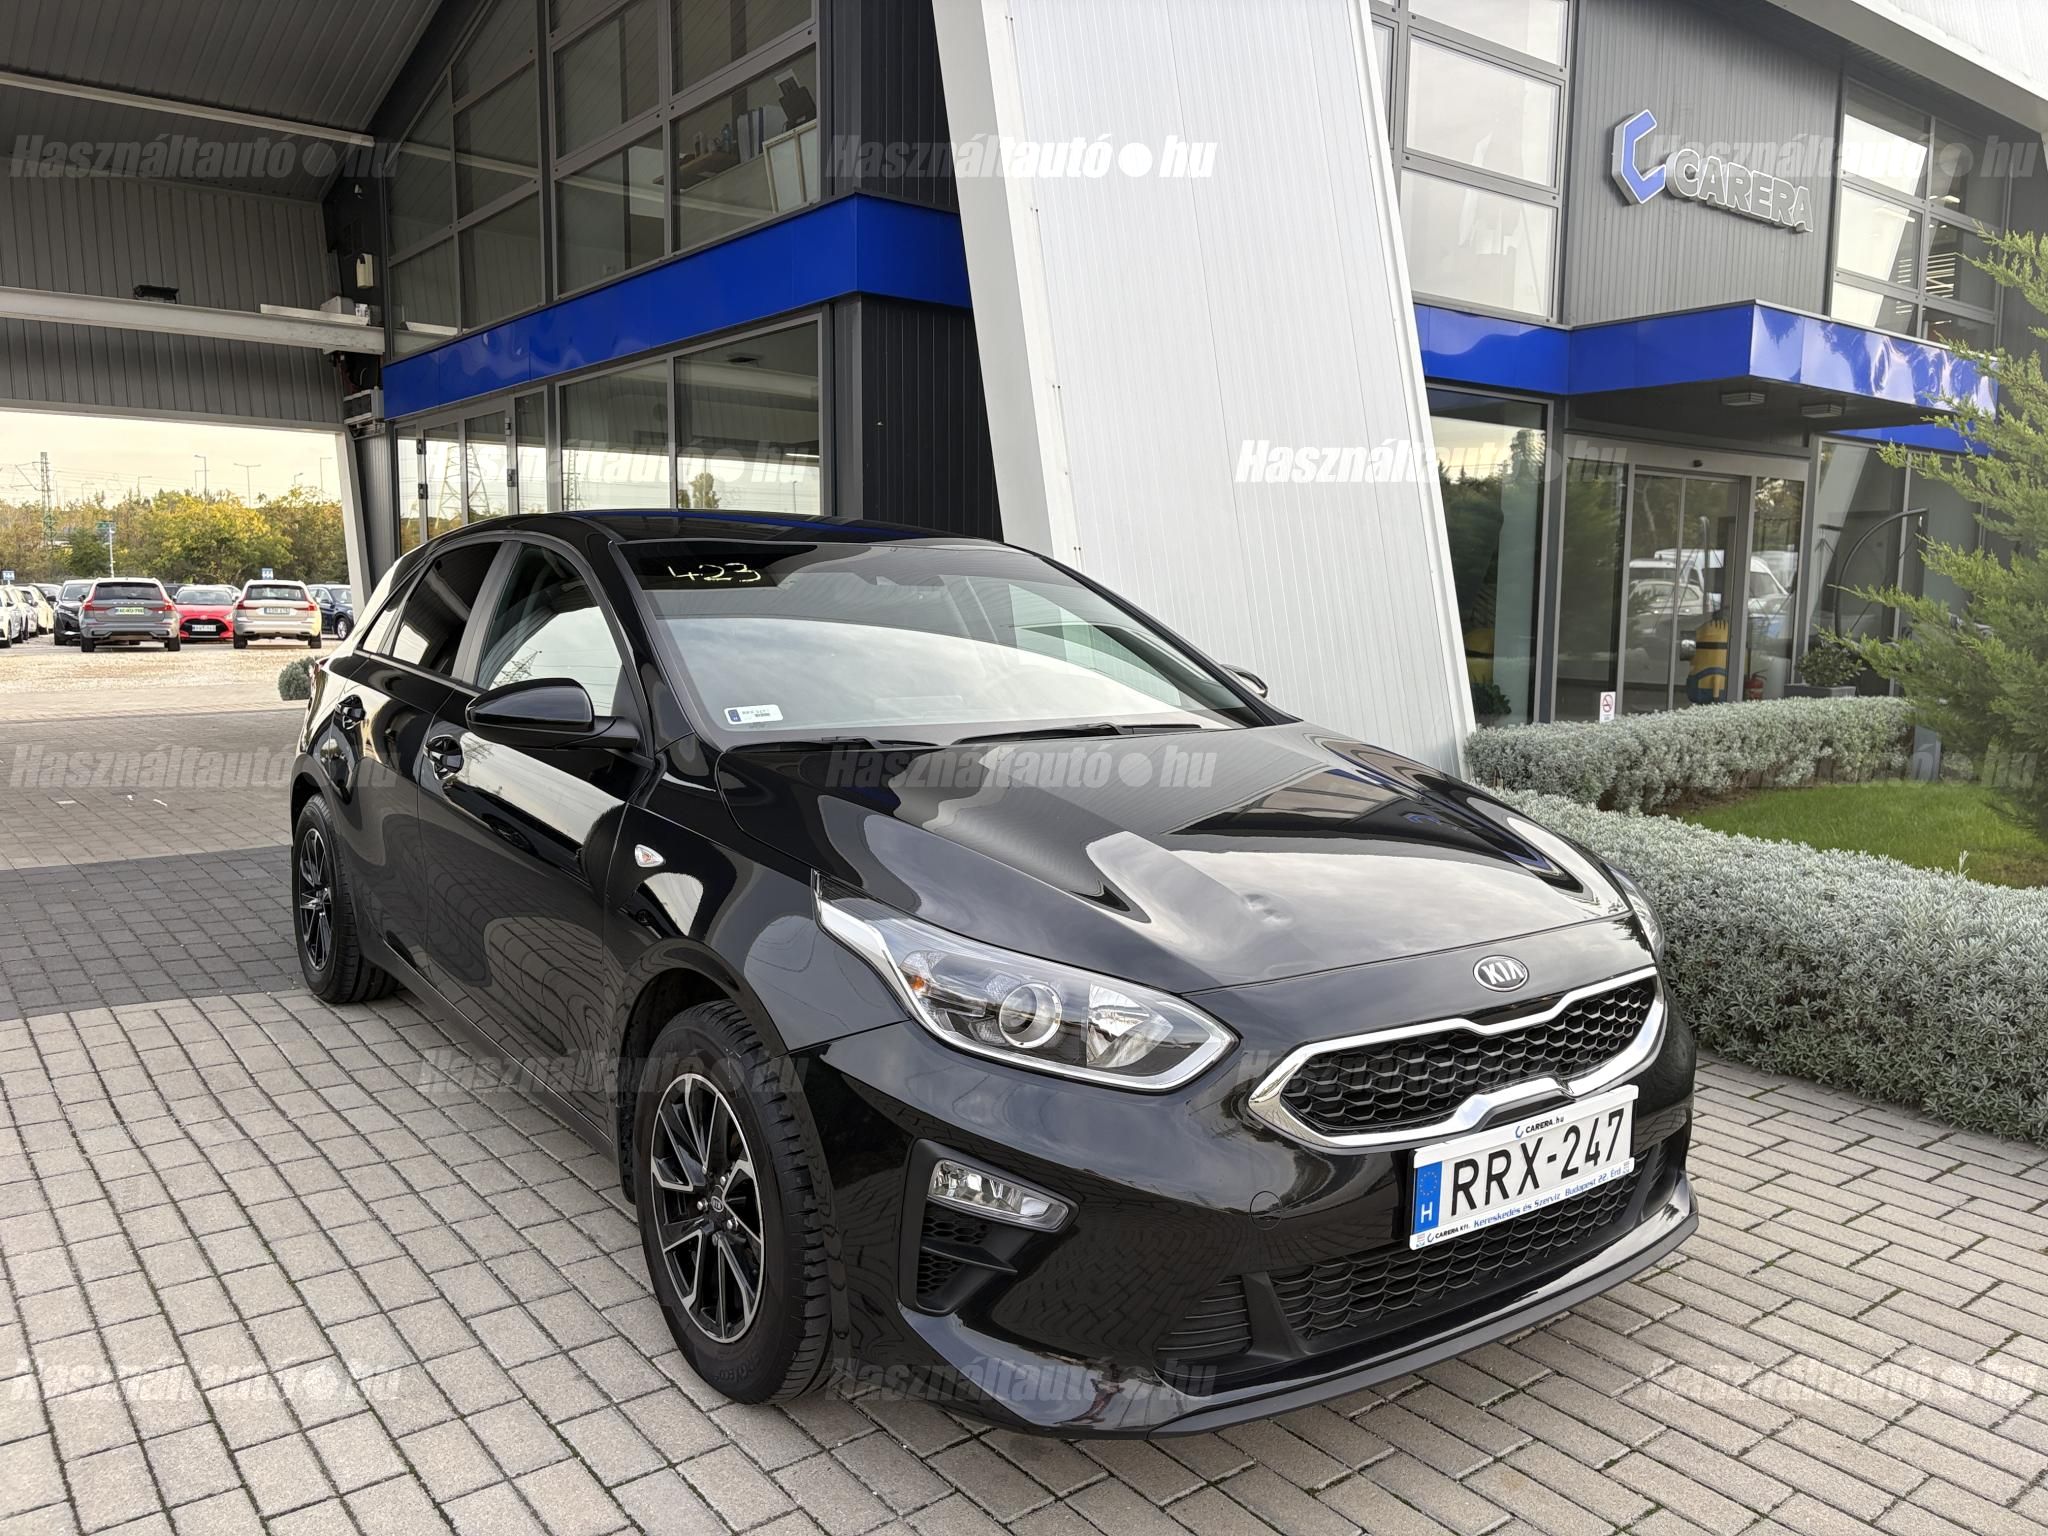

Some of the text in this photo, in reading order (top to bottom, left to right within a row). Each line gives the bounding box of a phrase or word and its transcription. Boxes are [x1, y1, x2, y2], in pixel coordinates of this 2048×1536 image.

[1672, 147, 1814, 233] CARERA
[667, 562, 762, 583] 423
[1480, 959, 1525, 985] KIA
[1420, 1107, 1625, 1224] H RRX-247
[1434, 1226, 1459, 1239] CARERA
